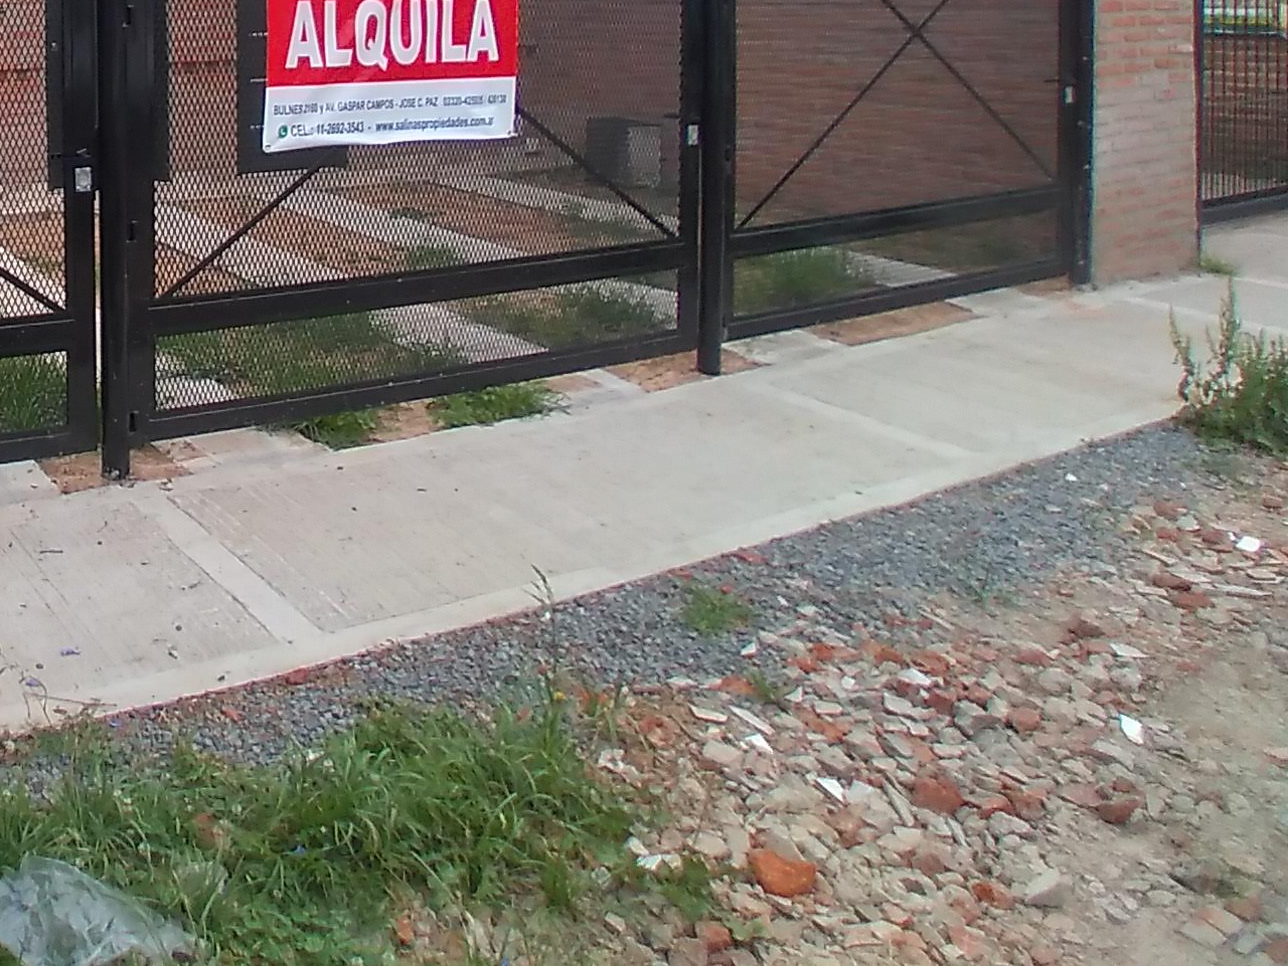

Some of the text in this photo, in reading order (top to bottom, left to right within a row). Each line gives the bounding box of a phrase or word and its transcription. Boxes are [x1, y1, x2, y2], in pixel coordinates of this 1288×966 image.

[273, 104, 304, 115] BULNES
[337, 101, 365, 112] GASPAR
[366, 99, 394, 110] CAMPOS
[425, 96, 438, 107] PAZ
[375, 116, 494, 132] www.salinaspropiedades.com.ar
